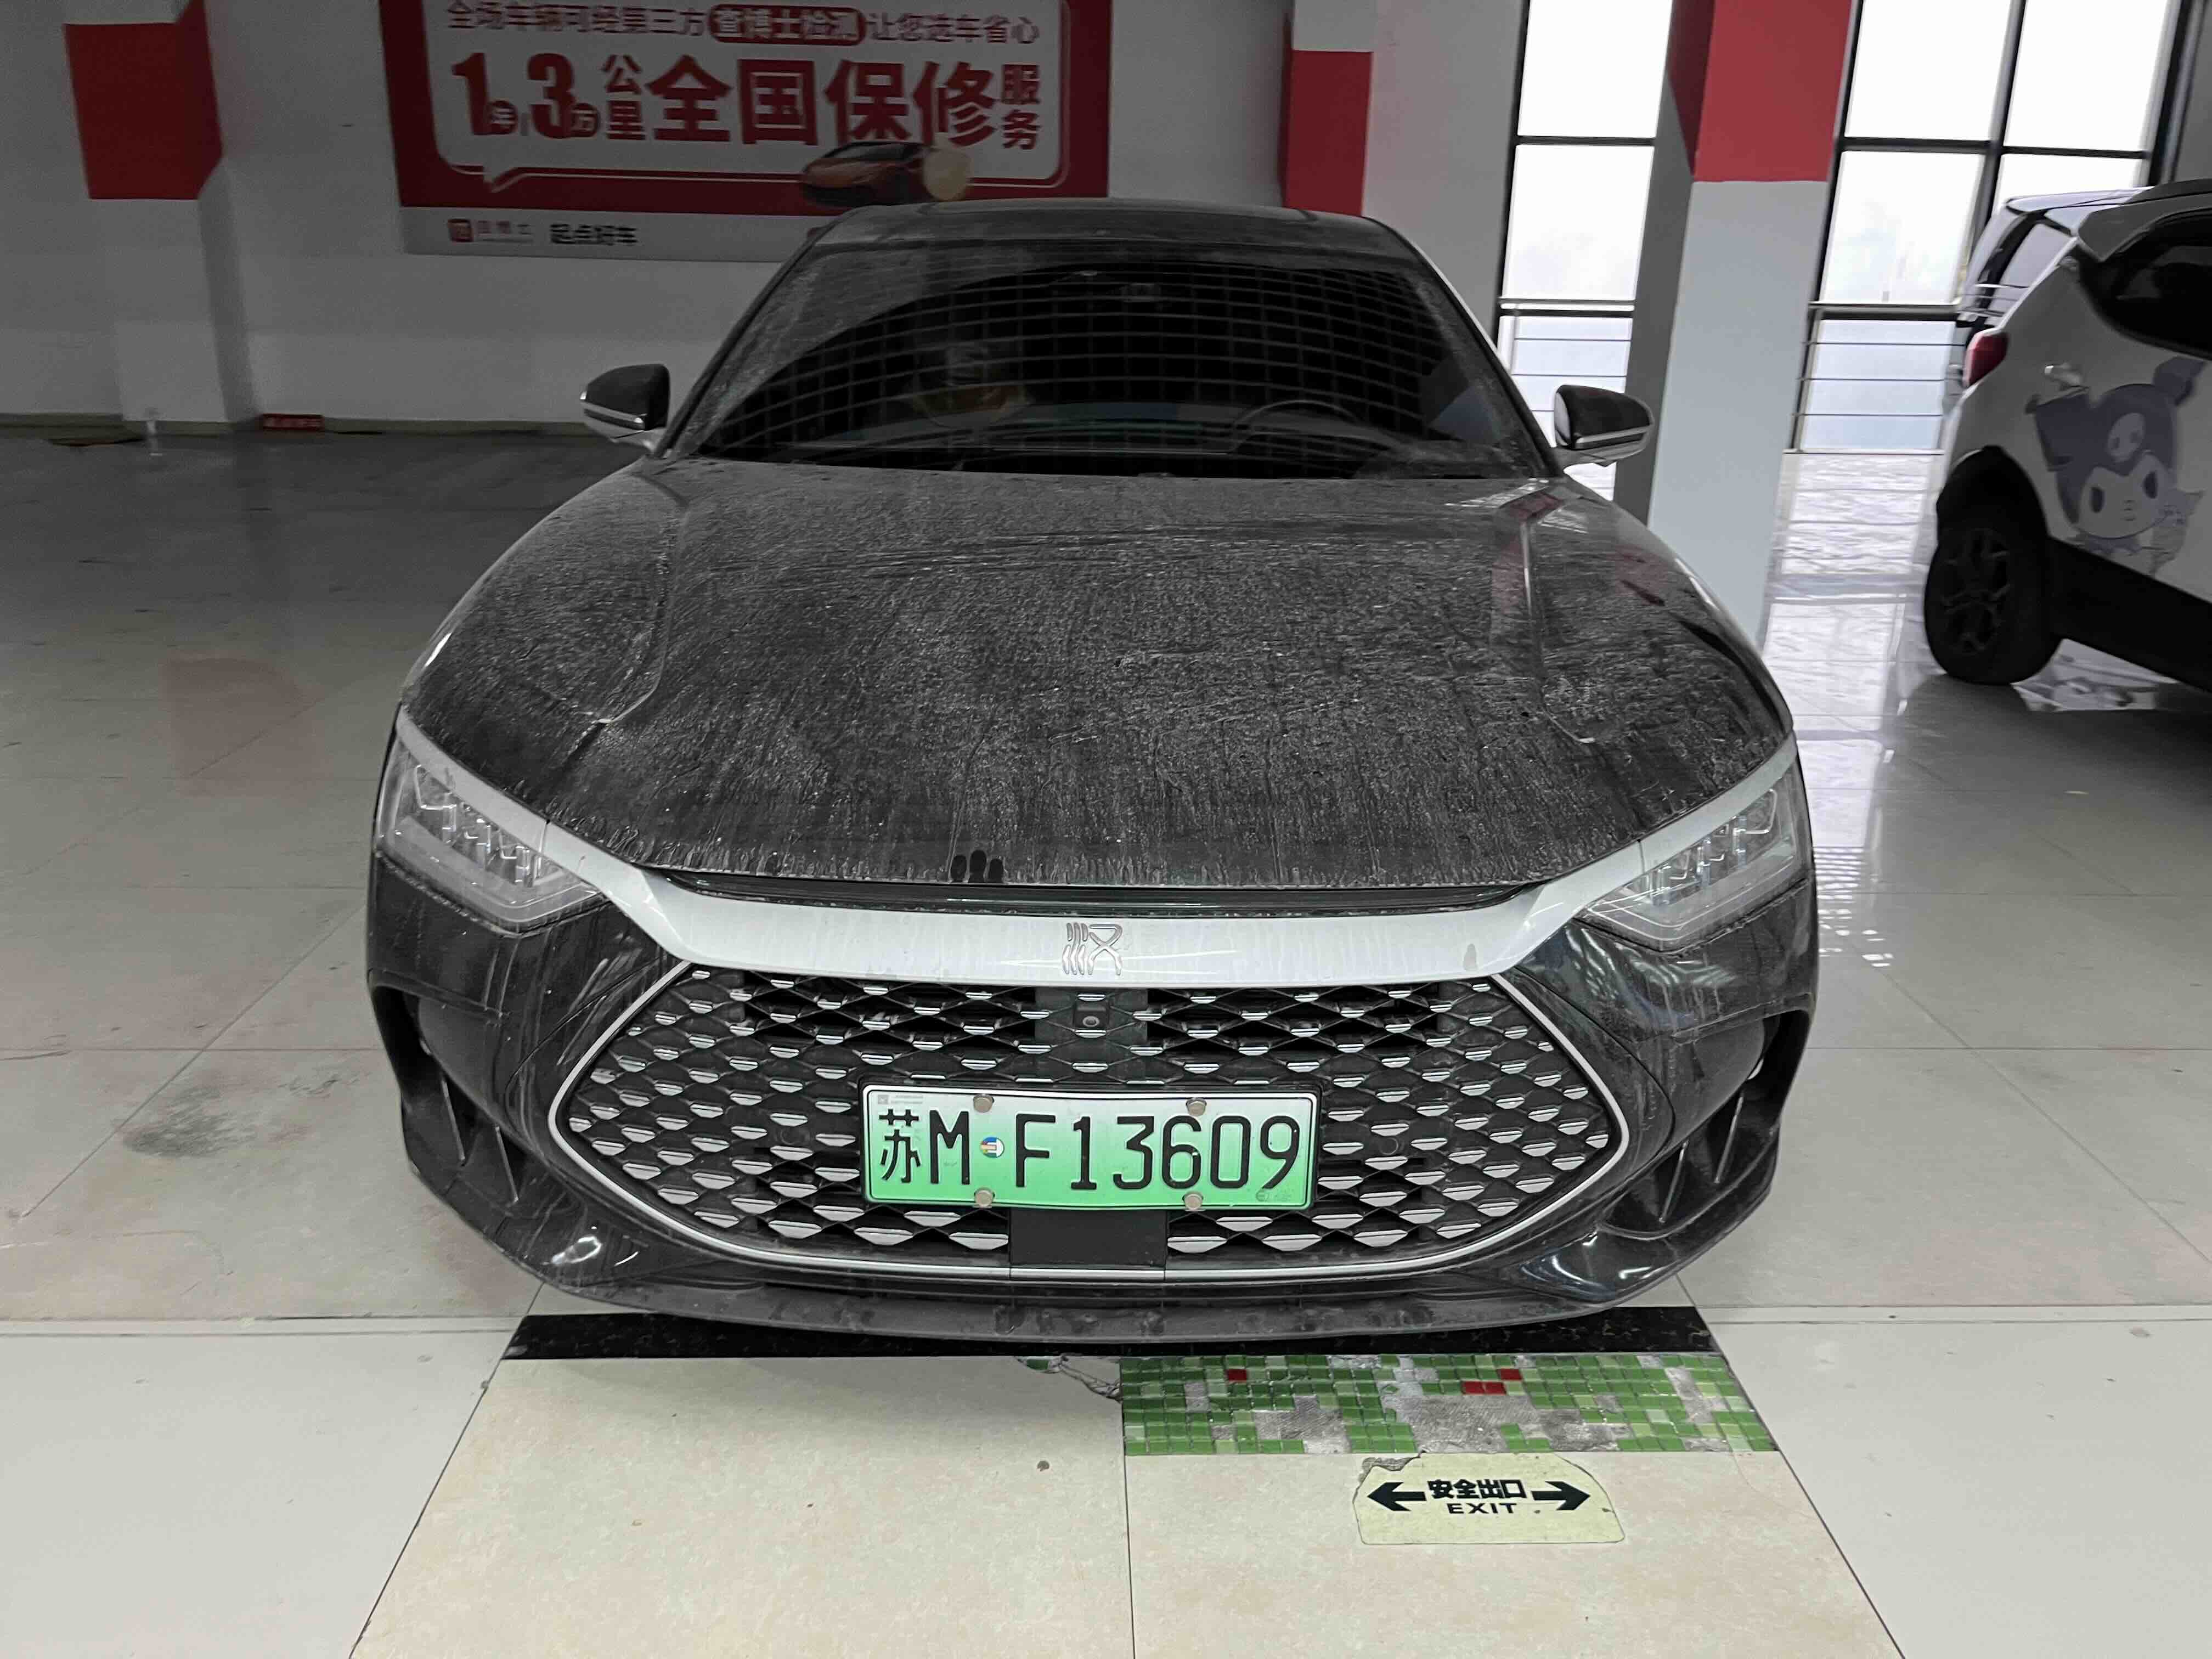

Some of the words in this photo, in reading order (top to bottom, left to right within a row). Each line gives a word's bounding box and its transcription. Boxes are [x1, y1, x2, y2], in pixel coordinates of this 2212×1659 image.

[1427, 1479, 1527, 1500] 安全出口
[1446, 1502, 1518, 1515] EXIT
